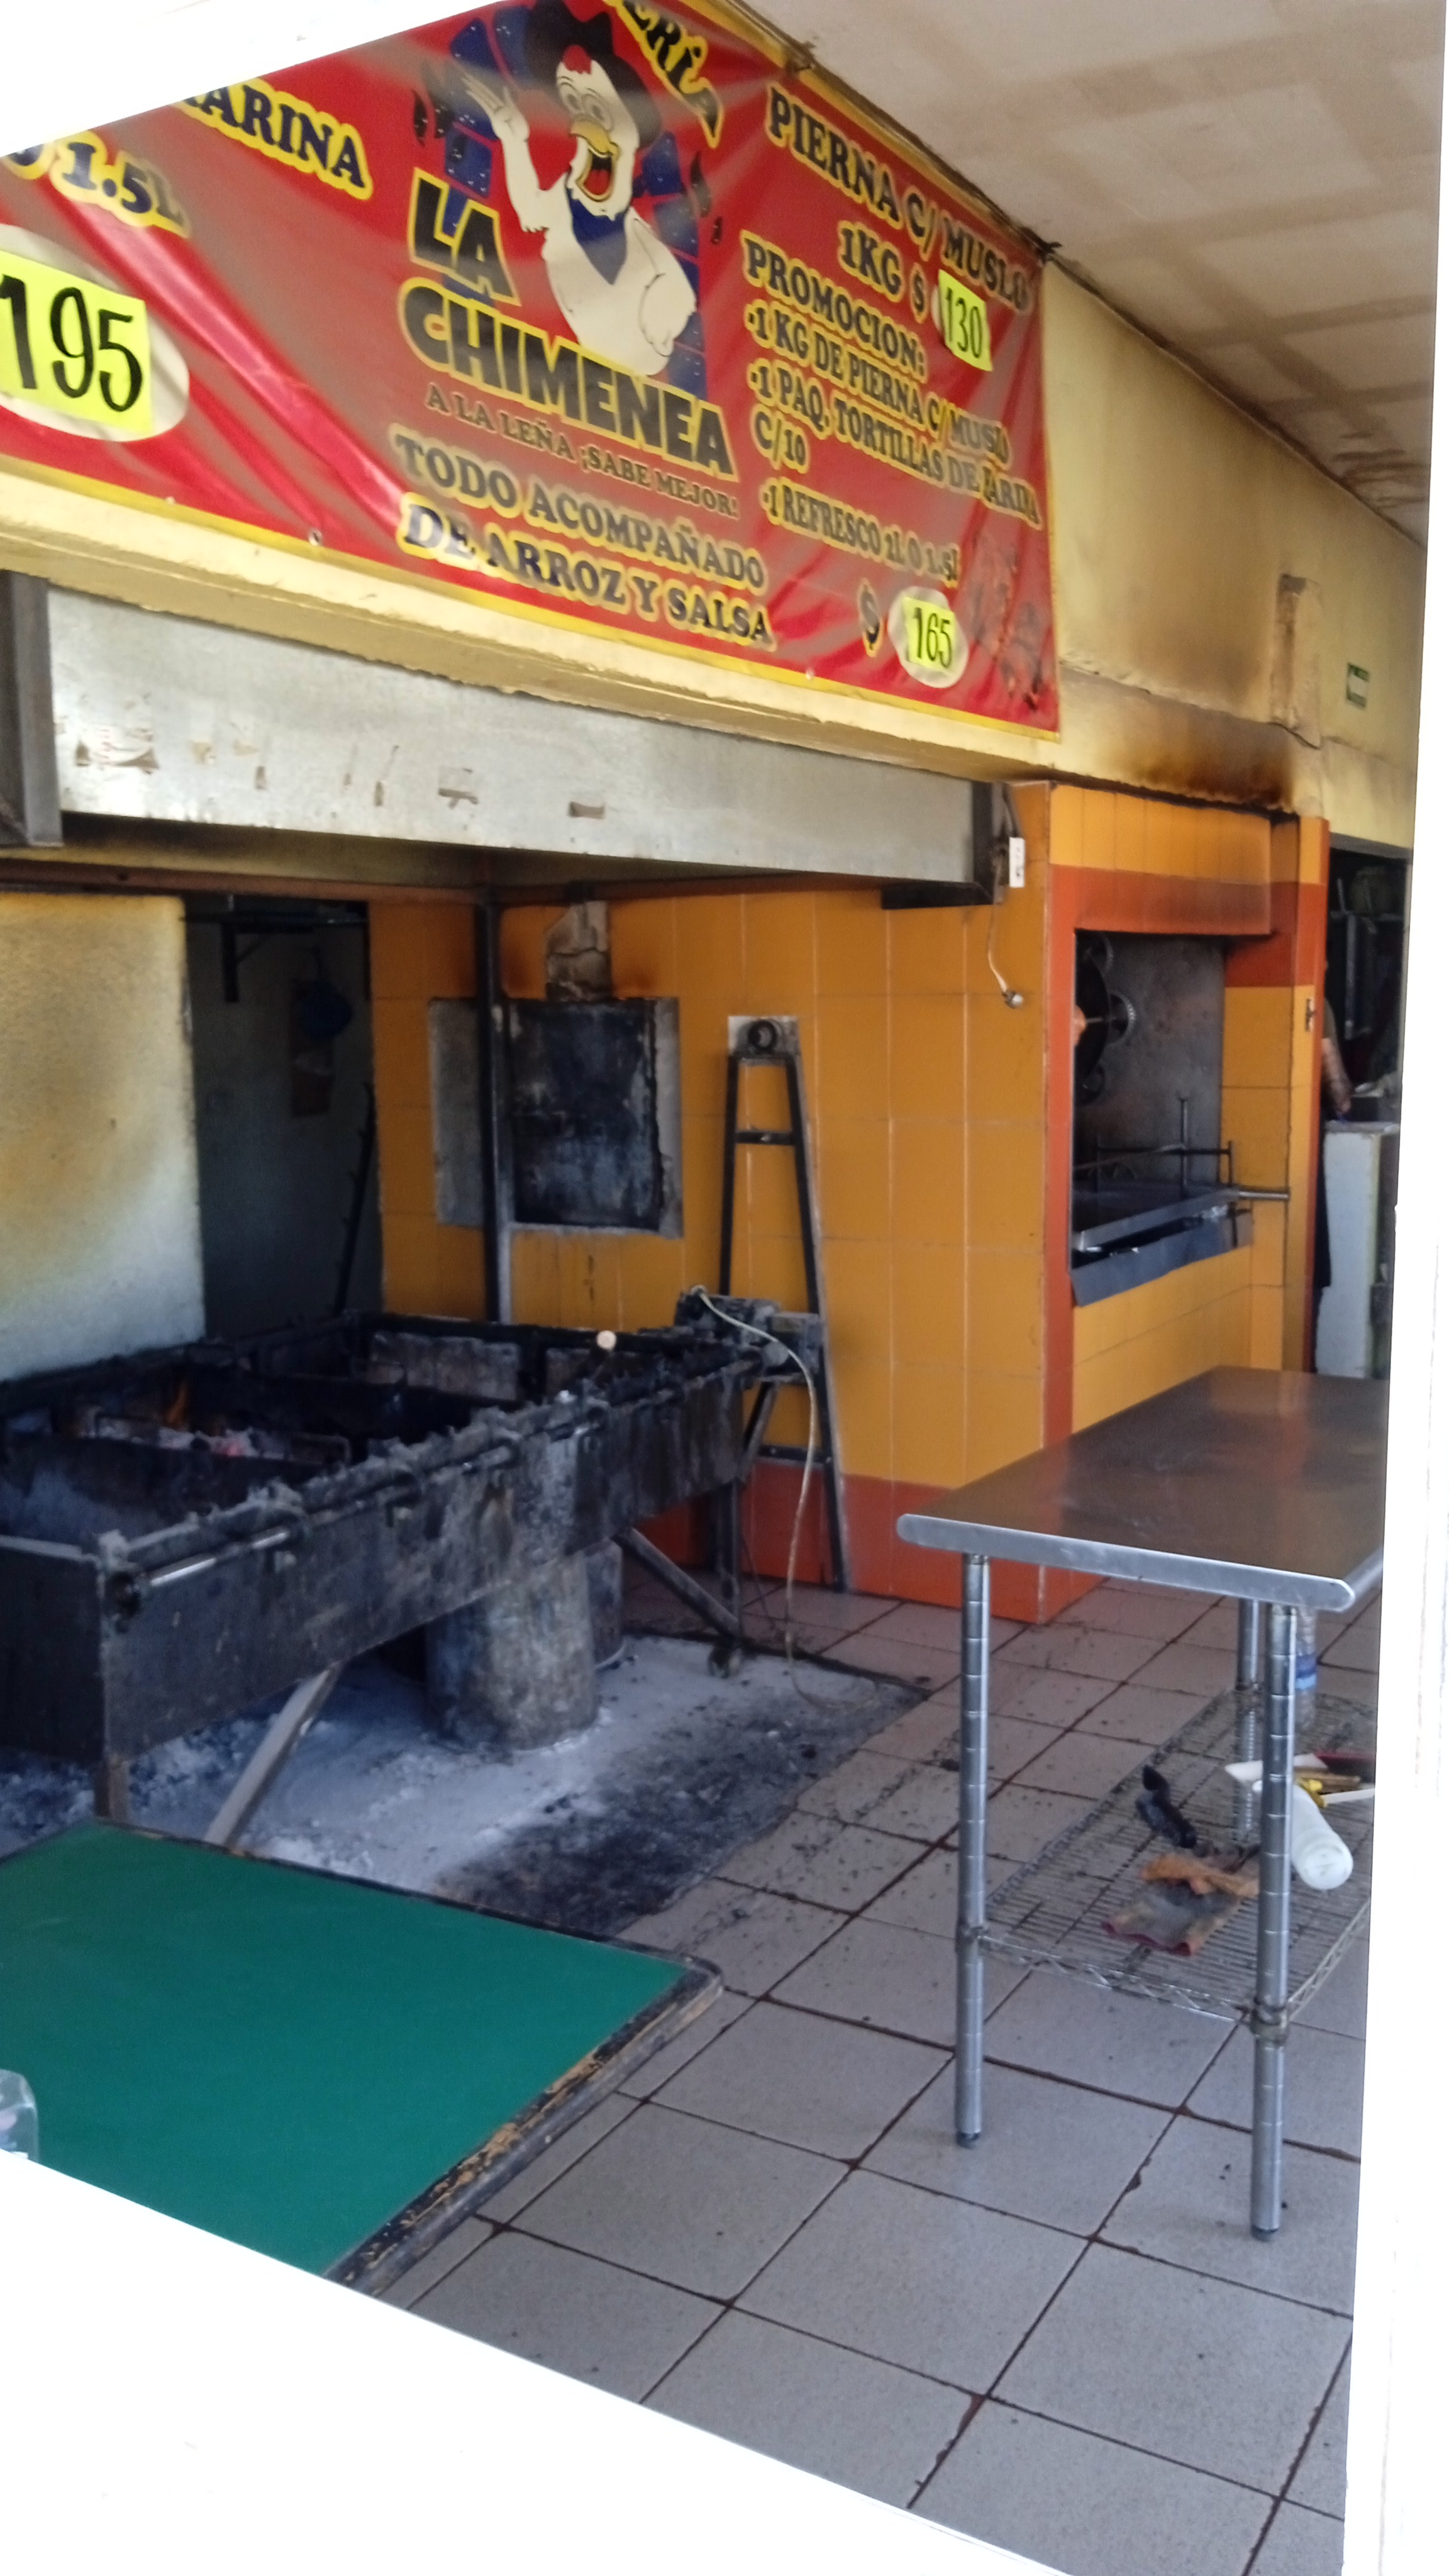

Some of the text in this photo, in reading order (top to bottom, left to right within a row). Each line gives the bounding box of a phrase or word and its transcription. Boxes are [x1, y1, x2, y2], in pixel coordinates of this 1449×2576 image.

[184, 84, 365, 189] ARINA
[769, 86, 901, 223] PIERNA
[411, 171, 519, 304] LA
[0, 275, 143, 413] 195
[743, 237, 925, 377] PROMOCION:
[945, 287, 983, 359] 130
[402, 284, 735, 477] CHIMENEA
[814, 332, 842, 375] DE
[849, 351, 924, 425] PIERNA
[835, 399, 943, 482] TORTILLAS
[395, 433, 765, 587] TODO ACOMPAÑADO
[429, 384, 448, 411] A
[455, 394, 495, 431] LA
[502, 412, 574, 460] LEÑA
[656, 470, 738, 517] MEJOR!
[404, 504, 771, 642] DE ARROZ Y SALSA
[783, 485, 881, 557] REFRESCO
[913, 606, 953, 669] 165
